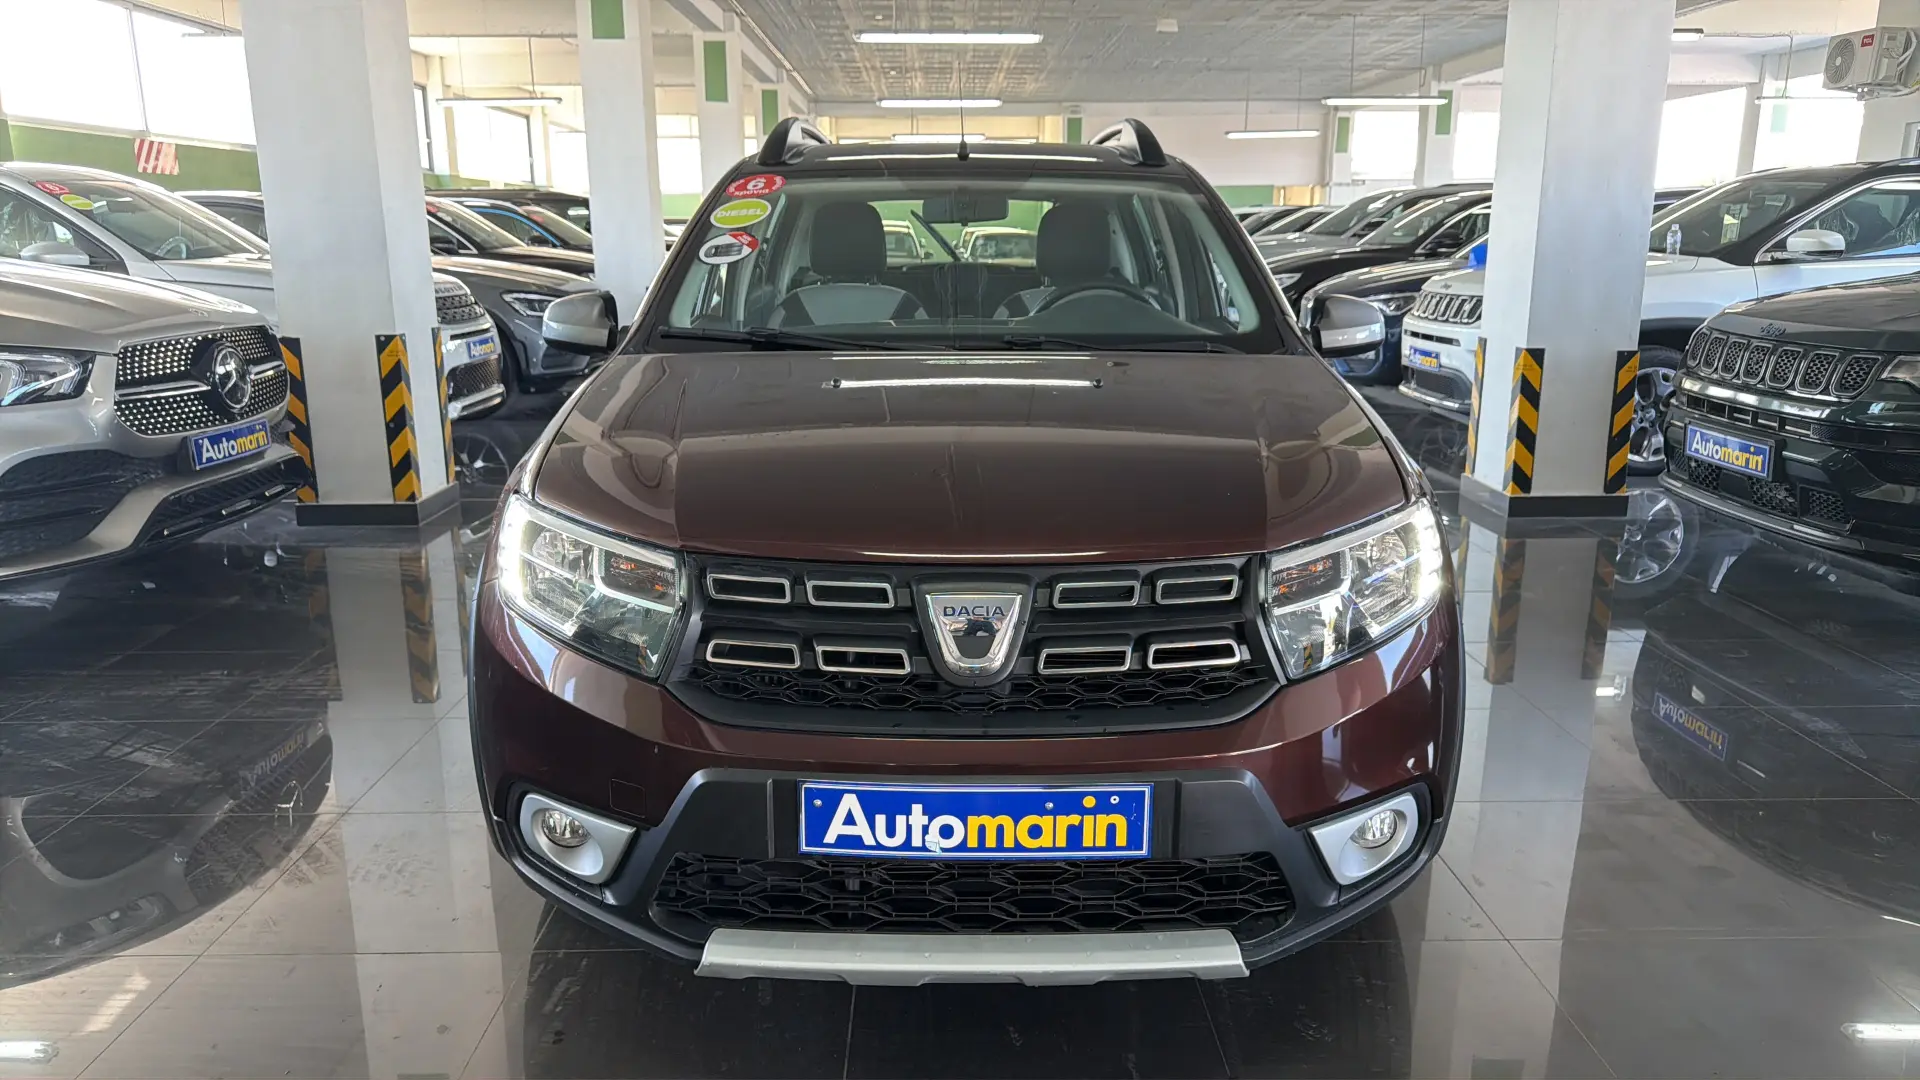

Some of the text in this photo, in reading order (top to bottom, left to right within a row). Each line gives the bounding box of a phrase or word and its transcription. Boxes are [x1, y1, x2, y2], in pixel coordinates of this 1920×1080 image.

[746, 176, 767, 190] 6
[716, 208, 764, 218] DIESEL
[202, 425, 268, 463] Automarin
[1691, 431, 1763, 471] Automarin
[943, 605, 1006, 617] DACIA
[823, 793, 1127, 848] Automarin
